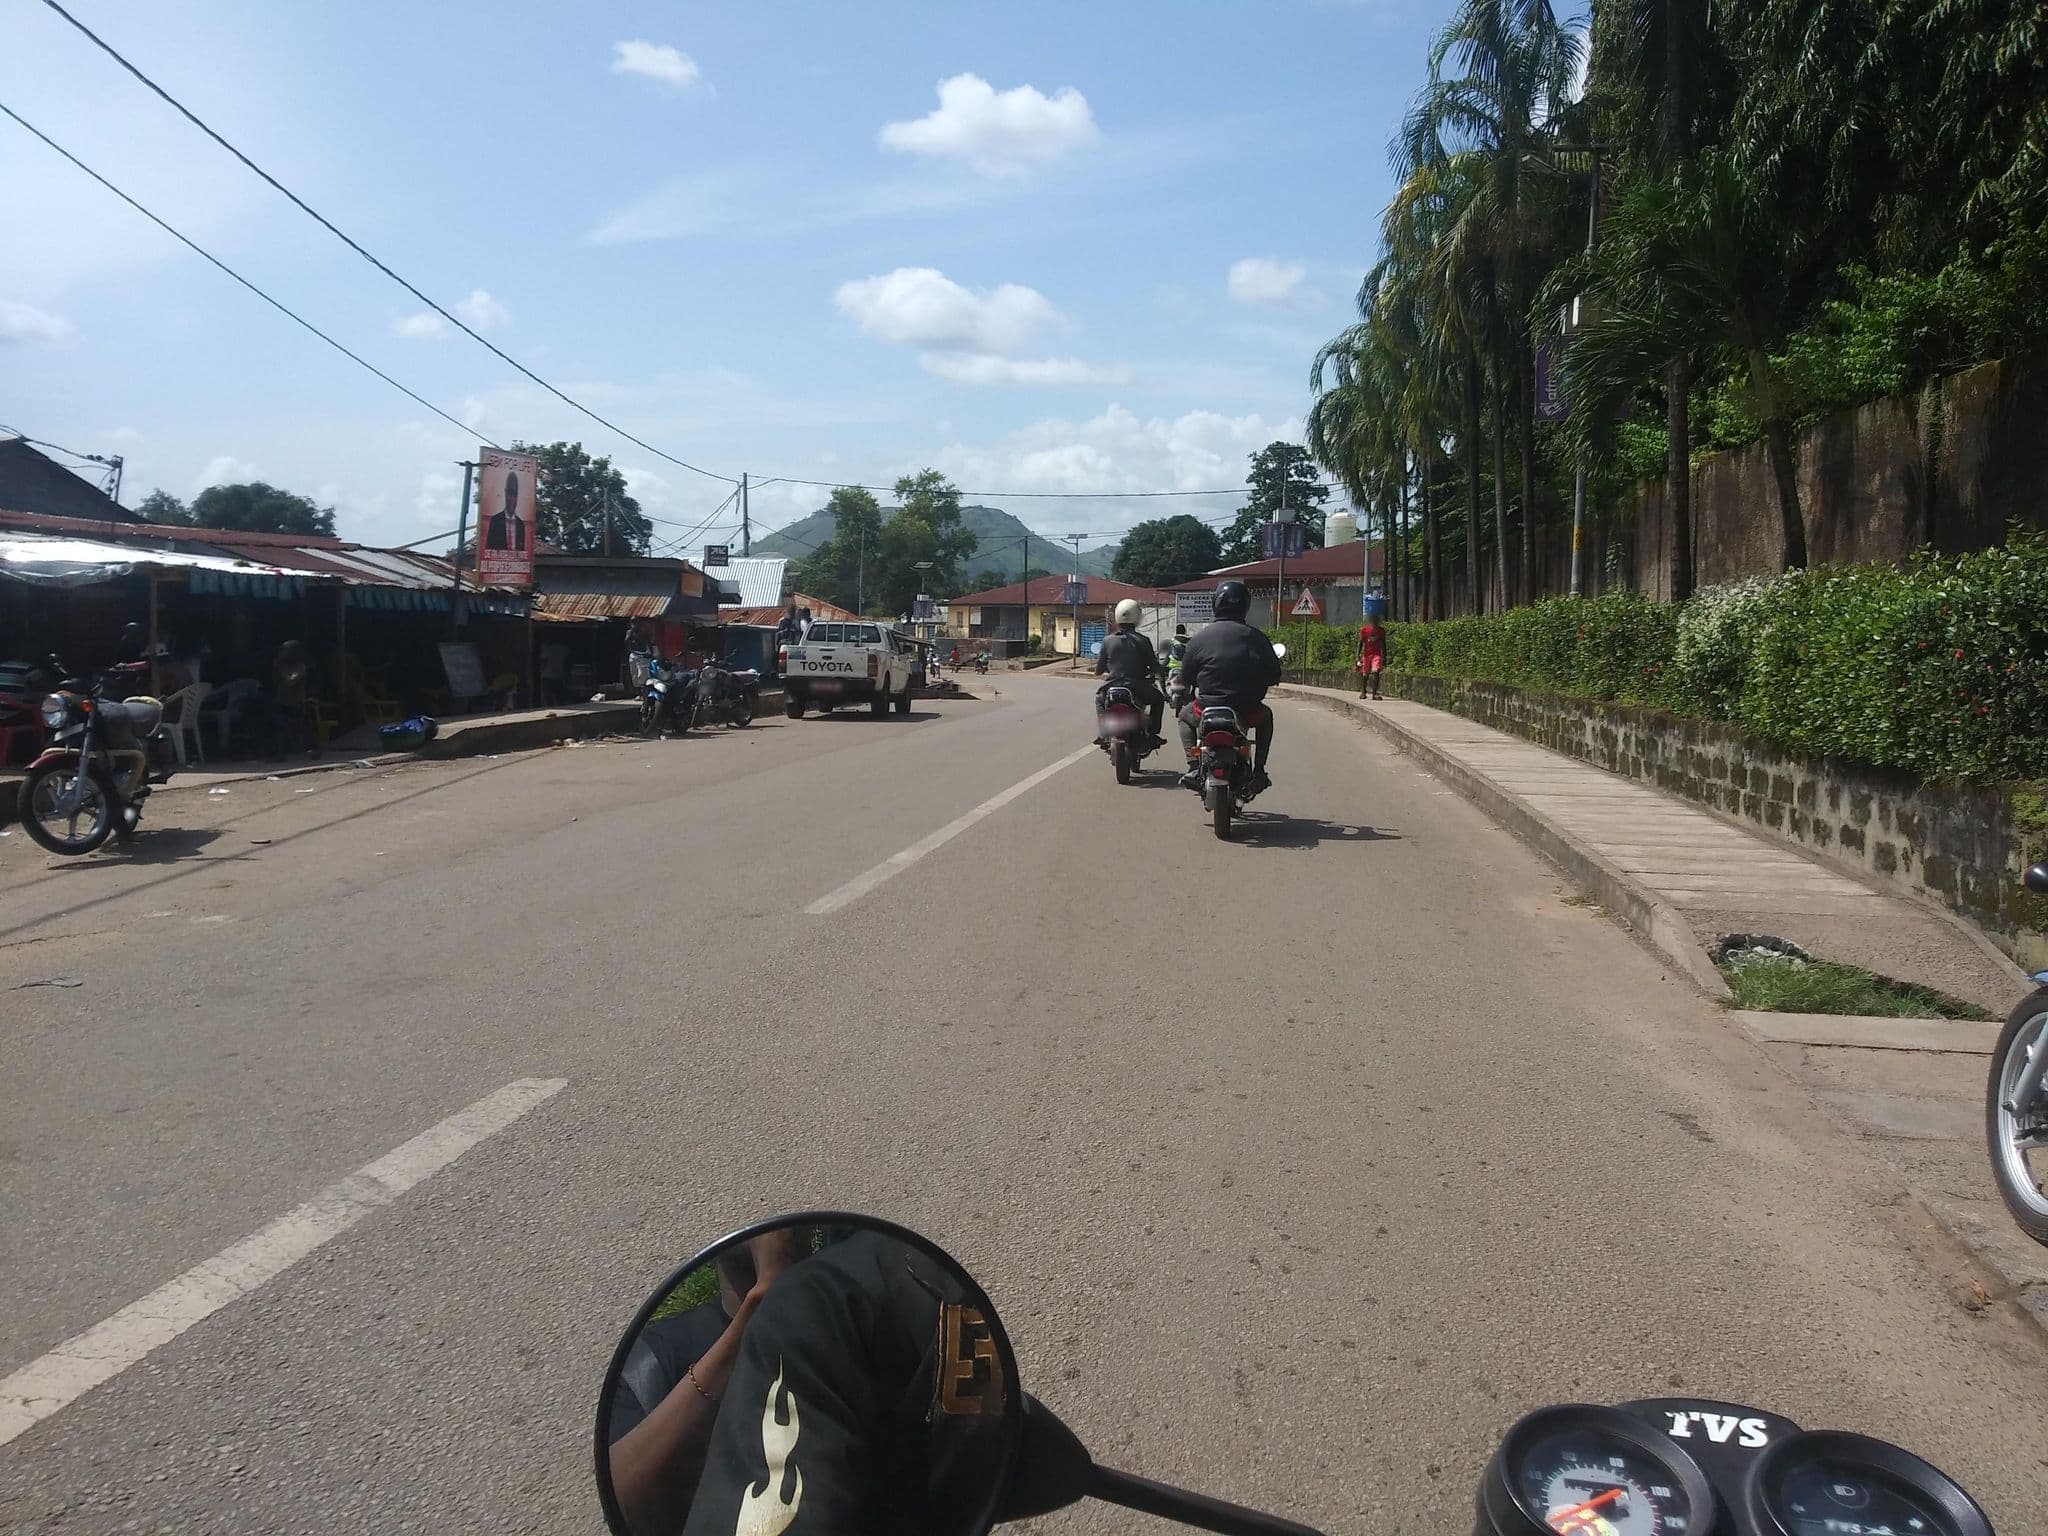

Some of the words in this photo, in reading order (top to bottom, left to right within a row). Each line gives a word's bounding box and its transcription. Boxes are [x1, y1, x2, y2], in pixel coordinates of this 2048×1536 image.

[800, 661, 853, 672] TOYOTA
[1664, 1411, 1768, 1448] TVS
[1650, 1485, 1671, 1498] 100
